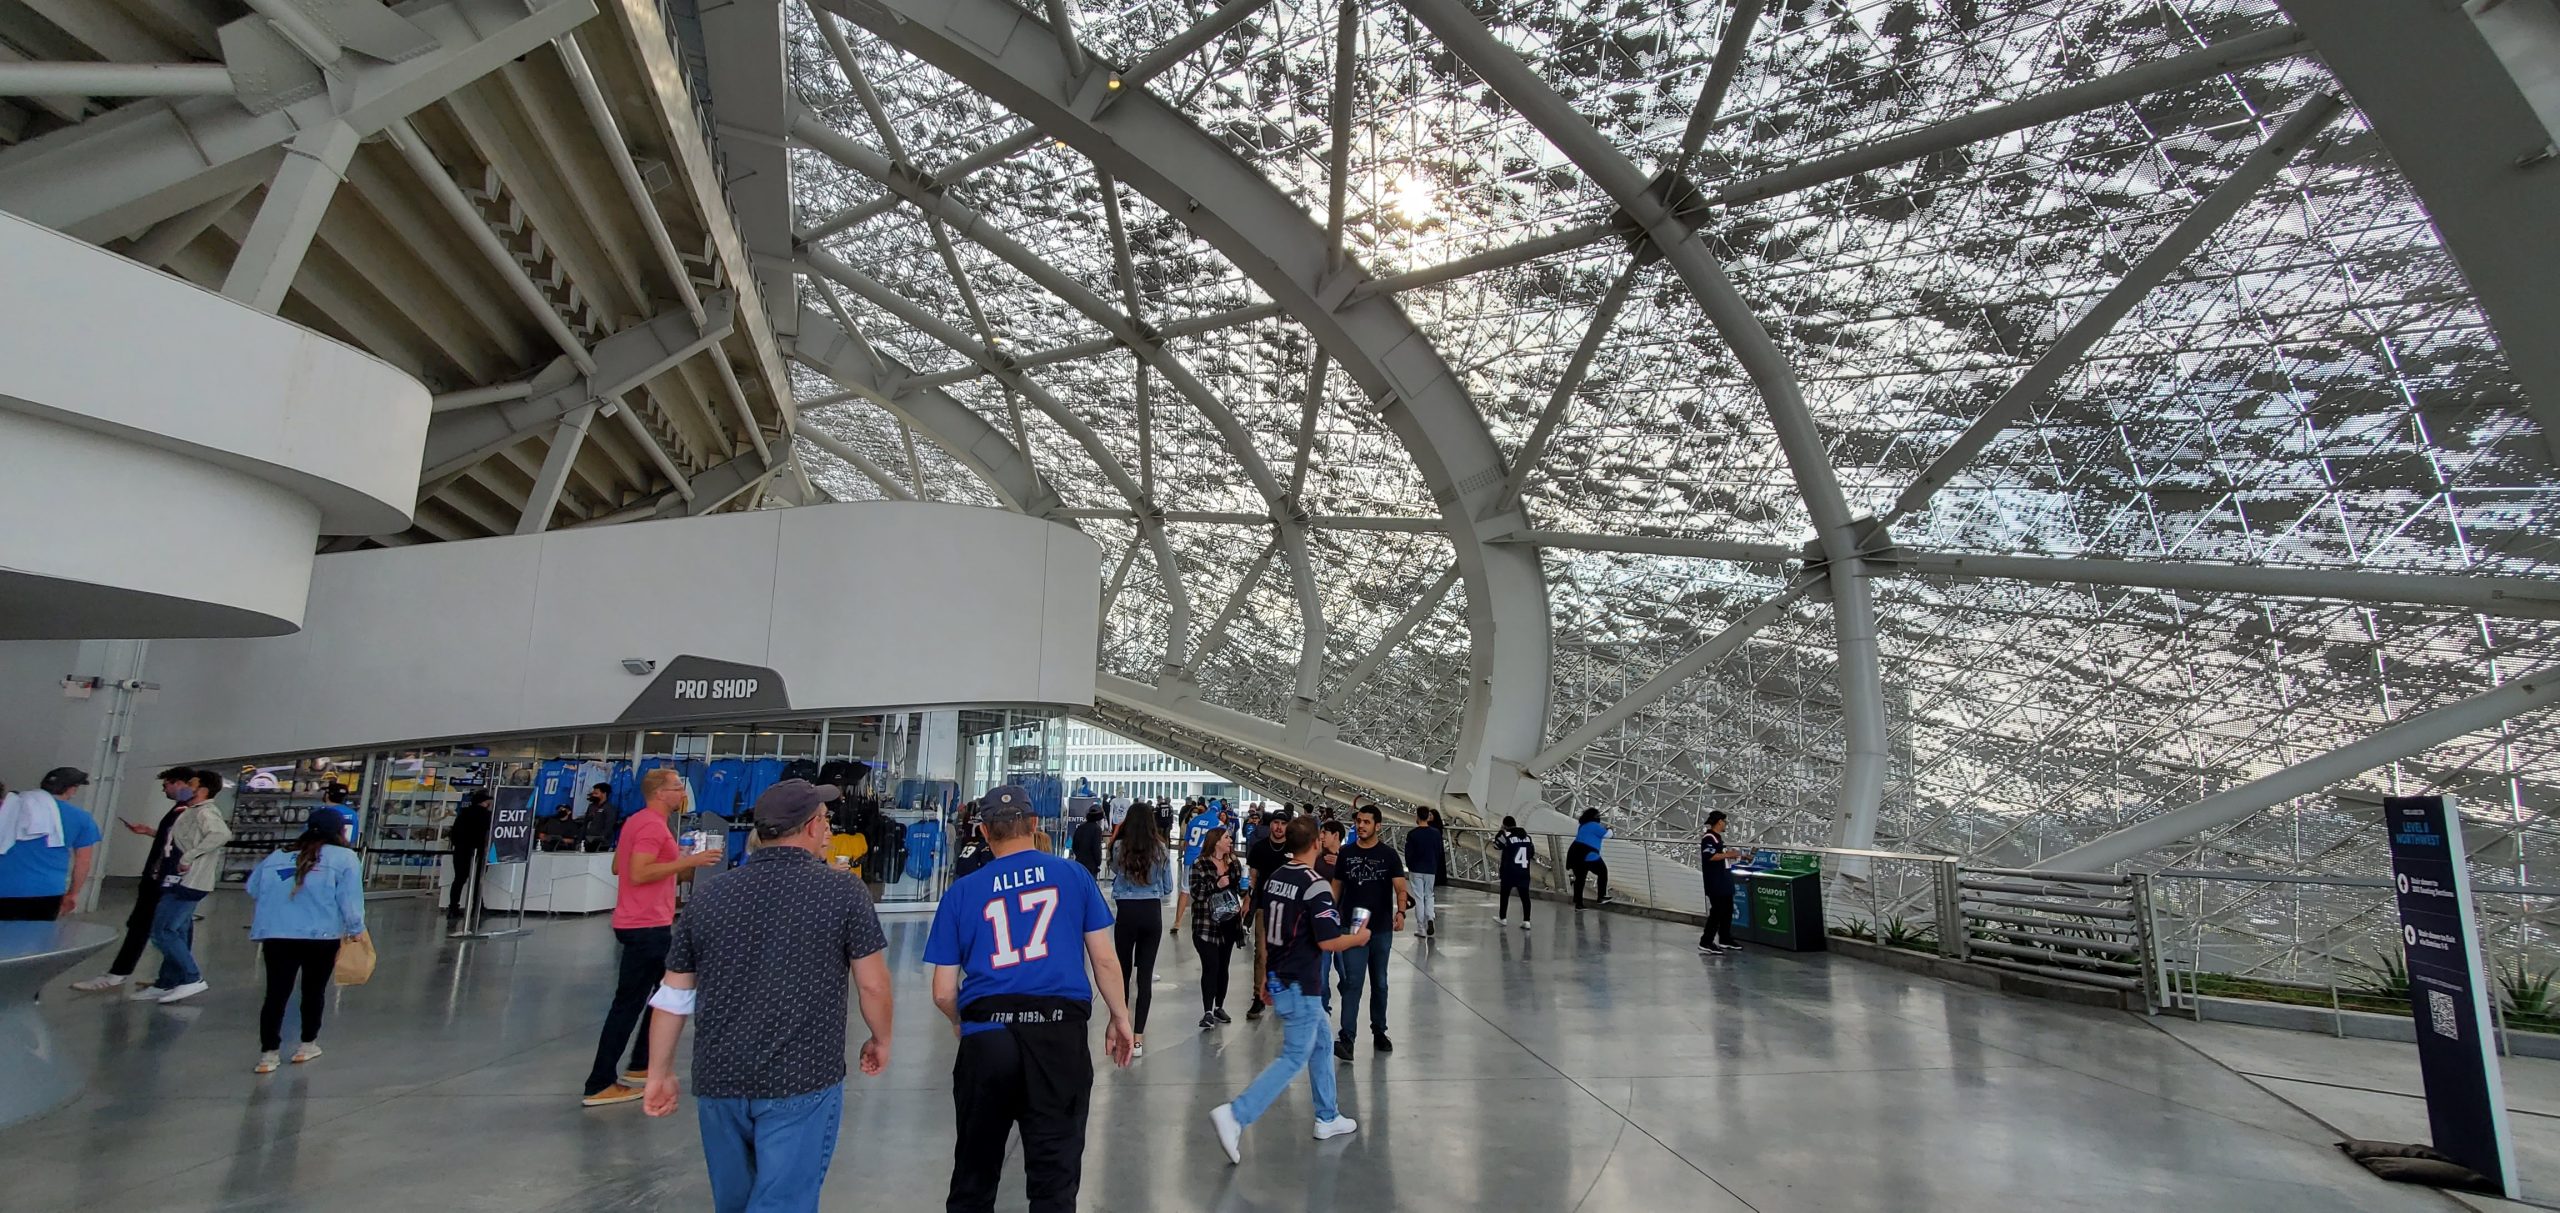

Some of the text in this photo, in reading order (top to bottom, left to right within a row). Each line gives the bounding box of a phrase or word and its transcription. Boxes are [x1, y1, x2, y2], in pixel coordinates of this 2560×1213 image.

[675, 679, 758, 699] PRO SHOP
[544, 778, 559, 795] 10
[499, 809, 527, 823] EXIT
[494, 825, 528, 839] ONLY
[1514, 846, 1529, 869] 4
[993, 866, 1045, 892] ALLEN
[1267, 879, 1299, 900] EDELMAN
[1757, 886, 1786, 897] COMPOST
[983, 886, 1059, 970] 17
[1267, 900, 1285, 946] 11
